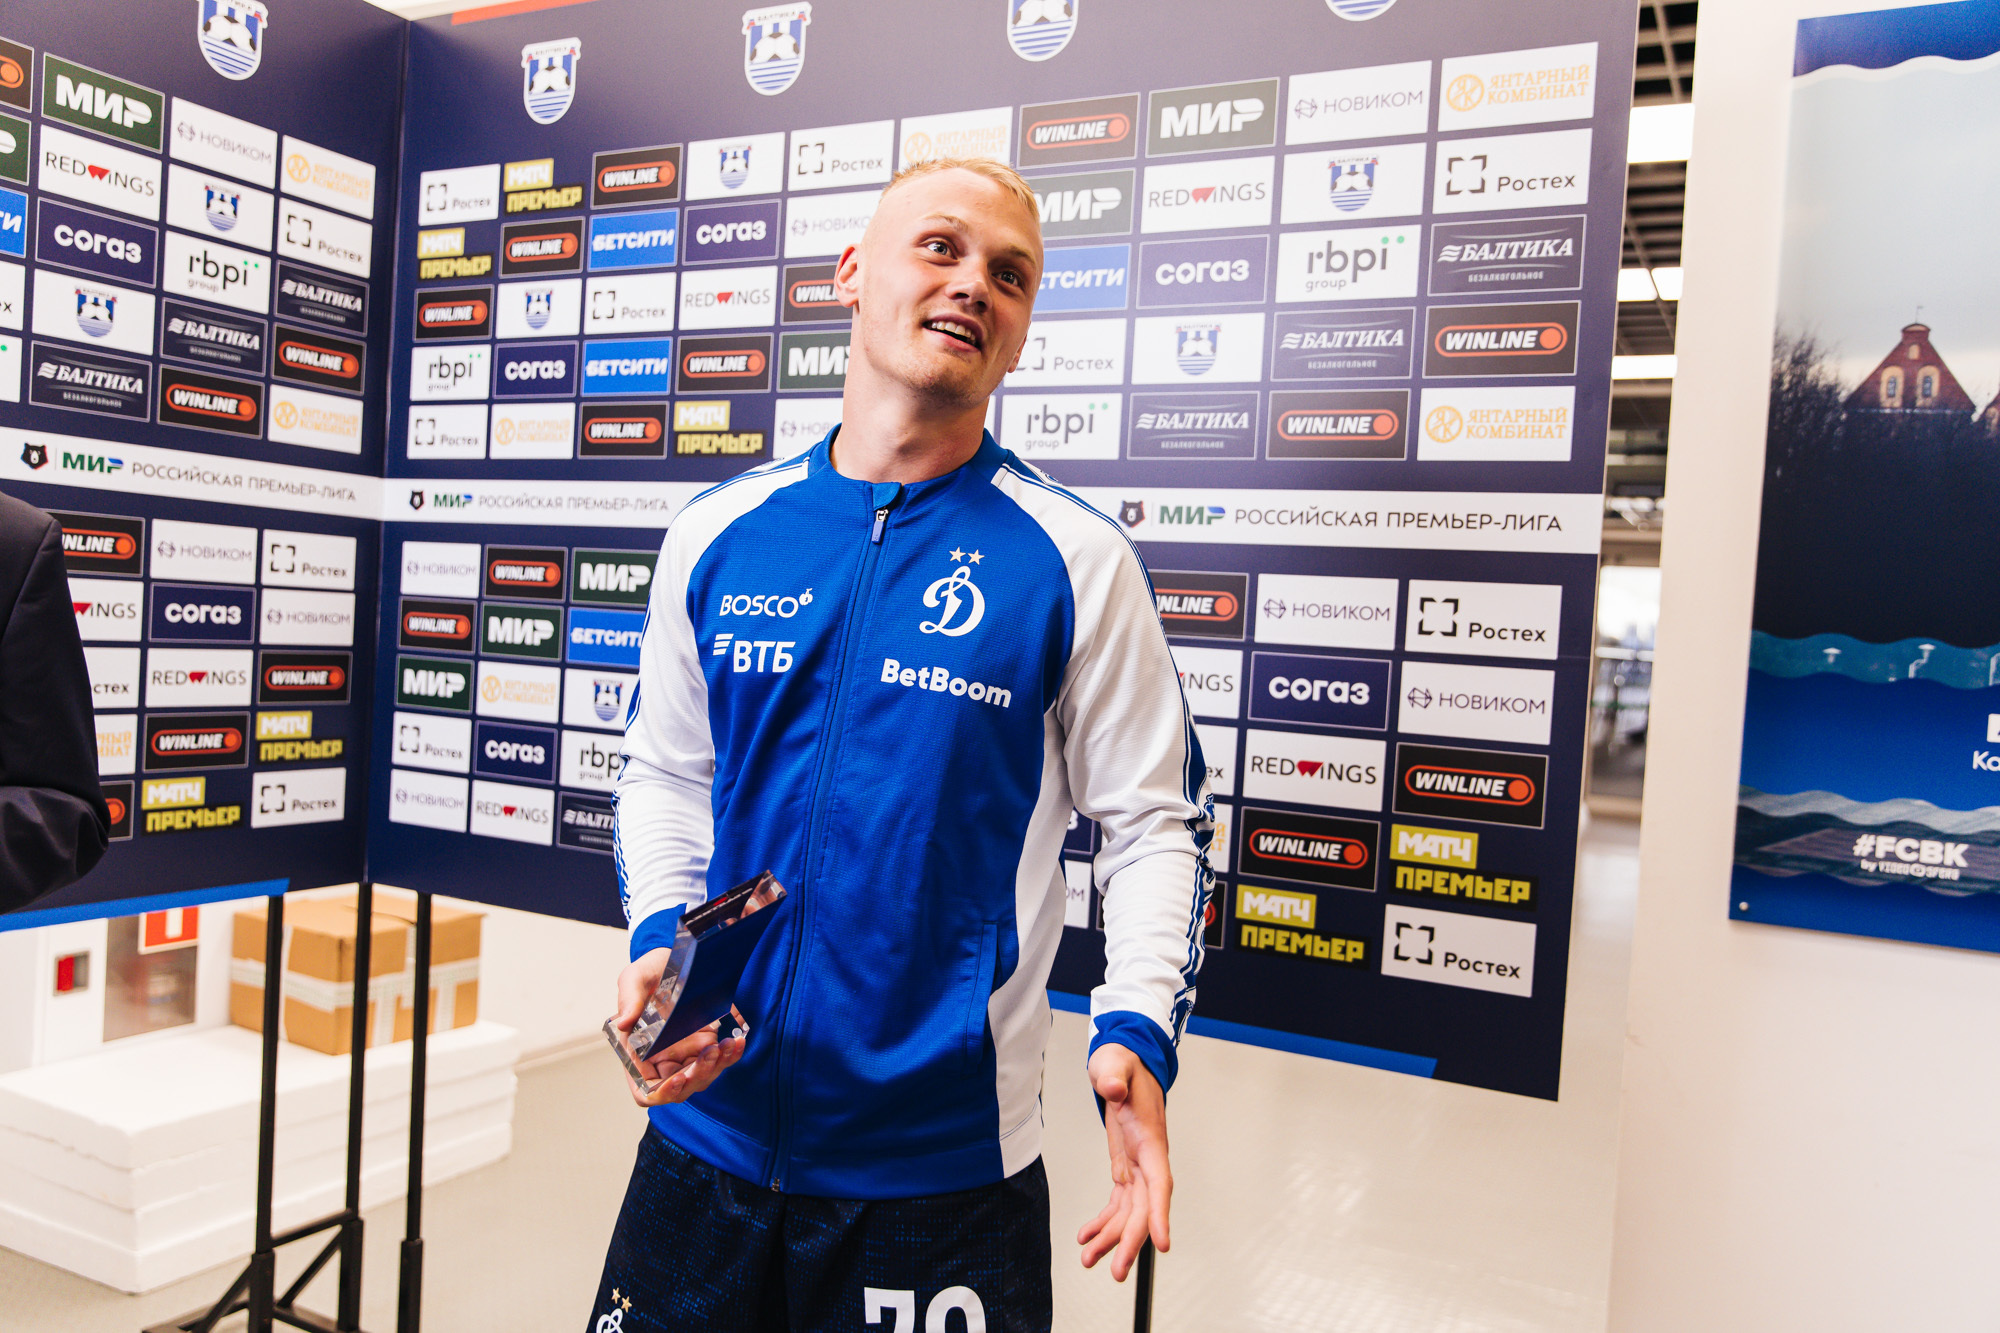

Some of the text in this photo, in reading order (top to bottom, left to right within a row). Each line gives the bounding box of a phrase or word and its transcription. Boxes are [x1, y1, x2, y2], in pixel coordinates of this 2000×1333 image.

[1488, 64, 1591, 89] ЯНТАРНЫЙ
[56, 74, 152, 128] МИР
[1324, 90, 1423, 114] НОВИКОМ
[1487, 81, 1589, 105] КОМБИНАТ
[1160, 98, 1265, 139] МИР
[1035, 121, 1107, 144] WINLINE
[200, 130, 272, 165] НОВИКОМ
[508, 163, 549, 188] МАТЧ
[832, 159, 883, 173] Ростех
[603, 168, 658, 188] WINLINE
[1497, 175, 1576, 192] Ростех
[812, 216, 871, 232] НОВИКО
[511, 239, 562, 256] WINLINE
[592, 229, 675, 252] БЕТСИТИ
[1460, 238, 1574, 262] БАЛТИКА
[1039, 268, 1125, 290] ТСИТИ
[1305, 277, 1347, 293] group
[1468, 271, 1544, 283] БЕЗАЛКОГОЛЬНОЕ
[295, 283, 363, 312] БАЛТИКА
[796, 285, 836, 303] WINL
[424, 306, 473, 323] WINLINE
[621, 306, 667, 320] Ростех
[183, 319, 260, 350] БАЛТИКА
[1301, 329, 1404, 349] БАЛТИКА
[1446, 329, 1538, 351] WINLINE
[286, 346, 342, 372] WINLINE
[586, 357, 668, 377] БЕТСИТИ
[688, 355, 747, 373] WINLINE
[788, 346, 850, 377] МИ
[1054, 357, 1114, 370] Ростех
[56, 364, 144, 394] БАЛТИКА
[173, 389, 238, 415] WINLINE
[678, 406, 726, 427] МАТЧ
[1154, 412, 1249, 430] БАЛТИКА
[1287, 416, 1371, 434] WINLINE
[1466, 407, 1568, 424] ЯНТАРНЫЙ
[589, 422, 647, 440] WINLINE
[1466, 424, 1567, 440] КОМБИНАТ
[678, 433, 763, 455] ПРЕМЬЕР
[1025, 439, 1059, 451] group
[62, 452, 357, 502] МИР РОССИЙСКАЯ ПРЕМЬЕР-ЛИГА
[434, 494, 473, 507] МИР
[479, 493, 563, 510] РОССИЙСКАЯ
[1159, 505, 1562, 532] МИР РОССИЙСКАЯ ПРЕМЬЕР-ЛИГА
[180, 540, 252, 560] НОВИКОМ
[302, 563, 347, 577] Ростех
[494, 565, 545, 582] WINLINE
[580, 562, 651, 592] МИР
[719, 594, 799, 618] BOSCO
[1292, 602, 1390, 621] НОВИКОМ
[409, 618, 456, 634] WINLINE
[488, 616, 554, 646] МИР
[1469, 622, 1547, 643] Ростех
[732, 640, 796, 673] ВТБ
[271, 670, 328, 685] WINLINE
[403, 668, 465, 698] МИР
[880, 658, 1012, 709] BetBoom
[93, 684, 130, 694] стех
[1439, 692, 1546, 715] НОВИКОМ
[260, 714, 308, 736] МАТЧ
[159, 734, 224, 750] WINLINE
[260, 740, 343, 761] ПРЕМЬЕР
[581, 741, 620, 778] rbp
[147, 781, 201, 805] МАТЧ
[1415, 771, 1505, 797] WINLINE
[292, 799, 337, 812] Ростех
[147, 806, 240, 832] ПРЕМЬЕР
[1258, 835, 1342, 862] WINLINE
[1398, 830, 1471, 862] МАТЧ
[1853, 834, 1969, 867] #FCBK
[1861, 859, 1877, 872] by
[1395, 866, 1531, 903] ПРЕМЬЕР
[1242, 890, 1310, 924] МАТЧ
[1240, 924, 1365, 963] ПРЕМЬЕР
[1443, 951, 1520, 979] Ростех
